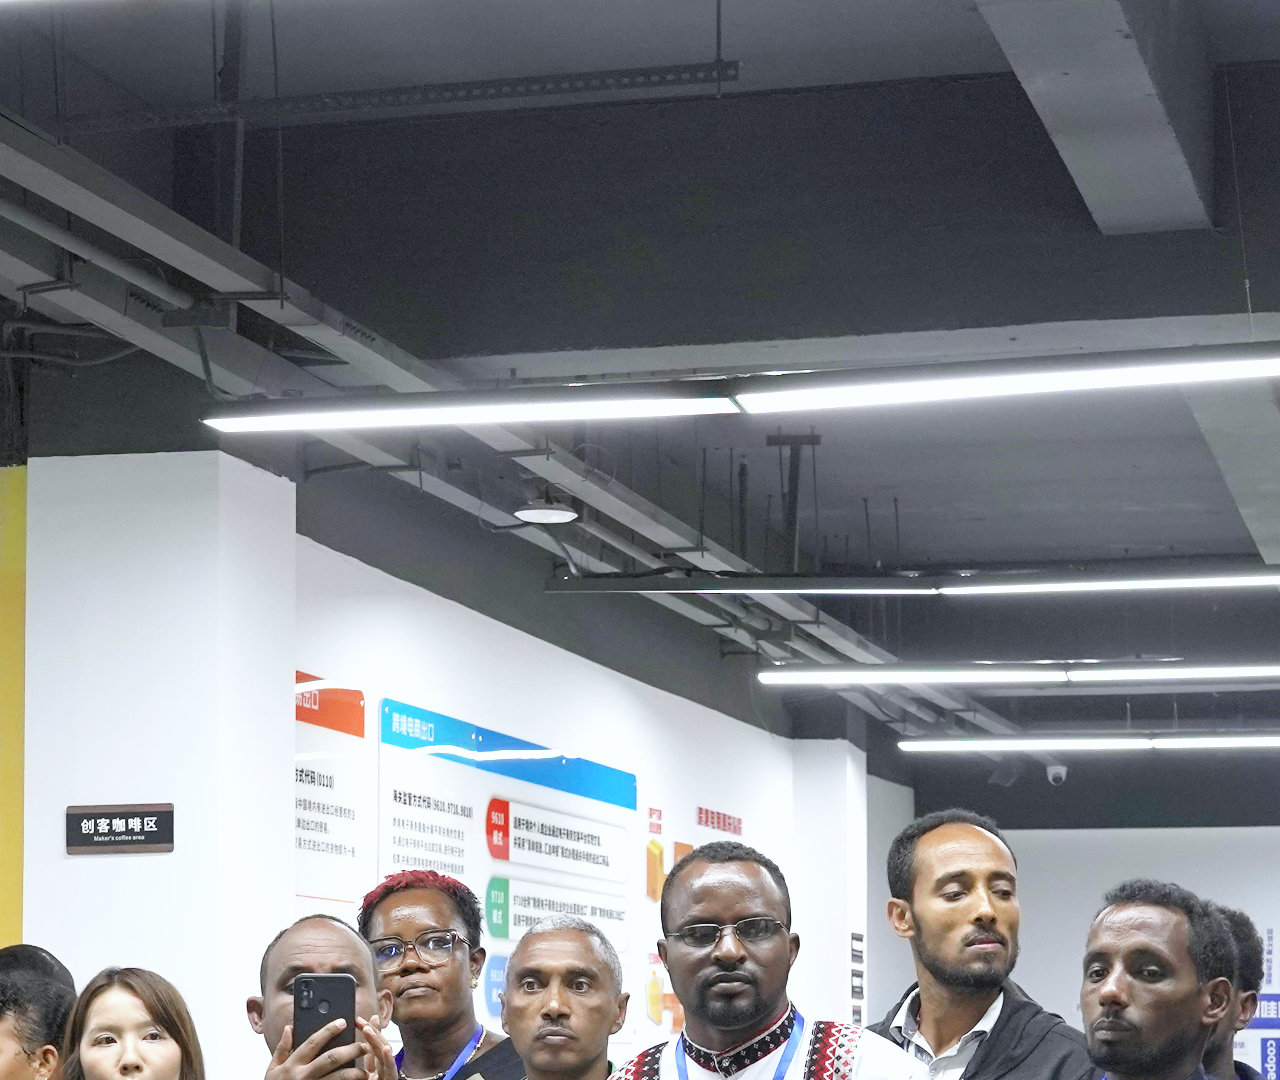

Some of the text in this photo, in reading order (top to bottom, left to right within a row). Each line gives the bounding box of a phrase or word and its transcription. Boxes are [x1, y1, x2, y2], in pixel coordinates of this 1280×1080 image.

[392, 712, 434, 742] 跨境电商出口
[81, 816, 158, 834] 创客咖啡区
[491, 811, 505, 826] 9610
[491, 890, 504, 904] 9710
